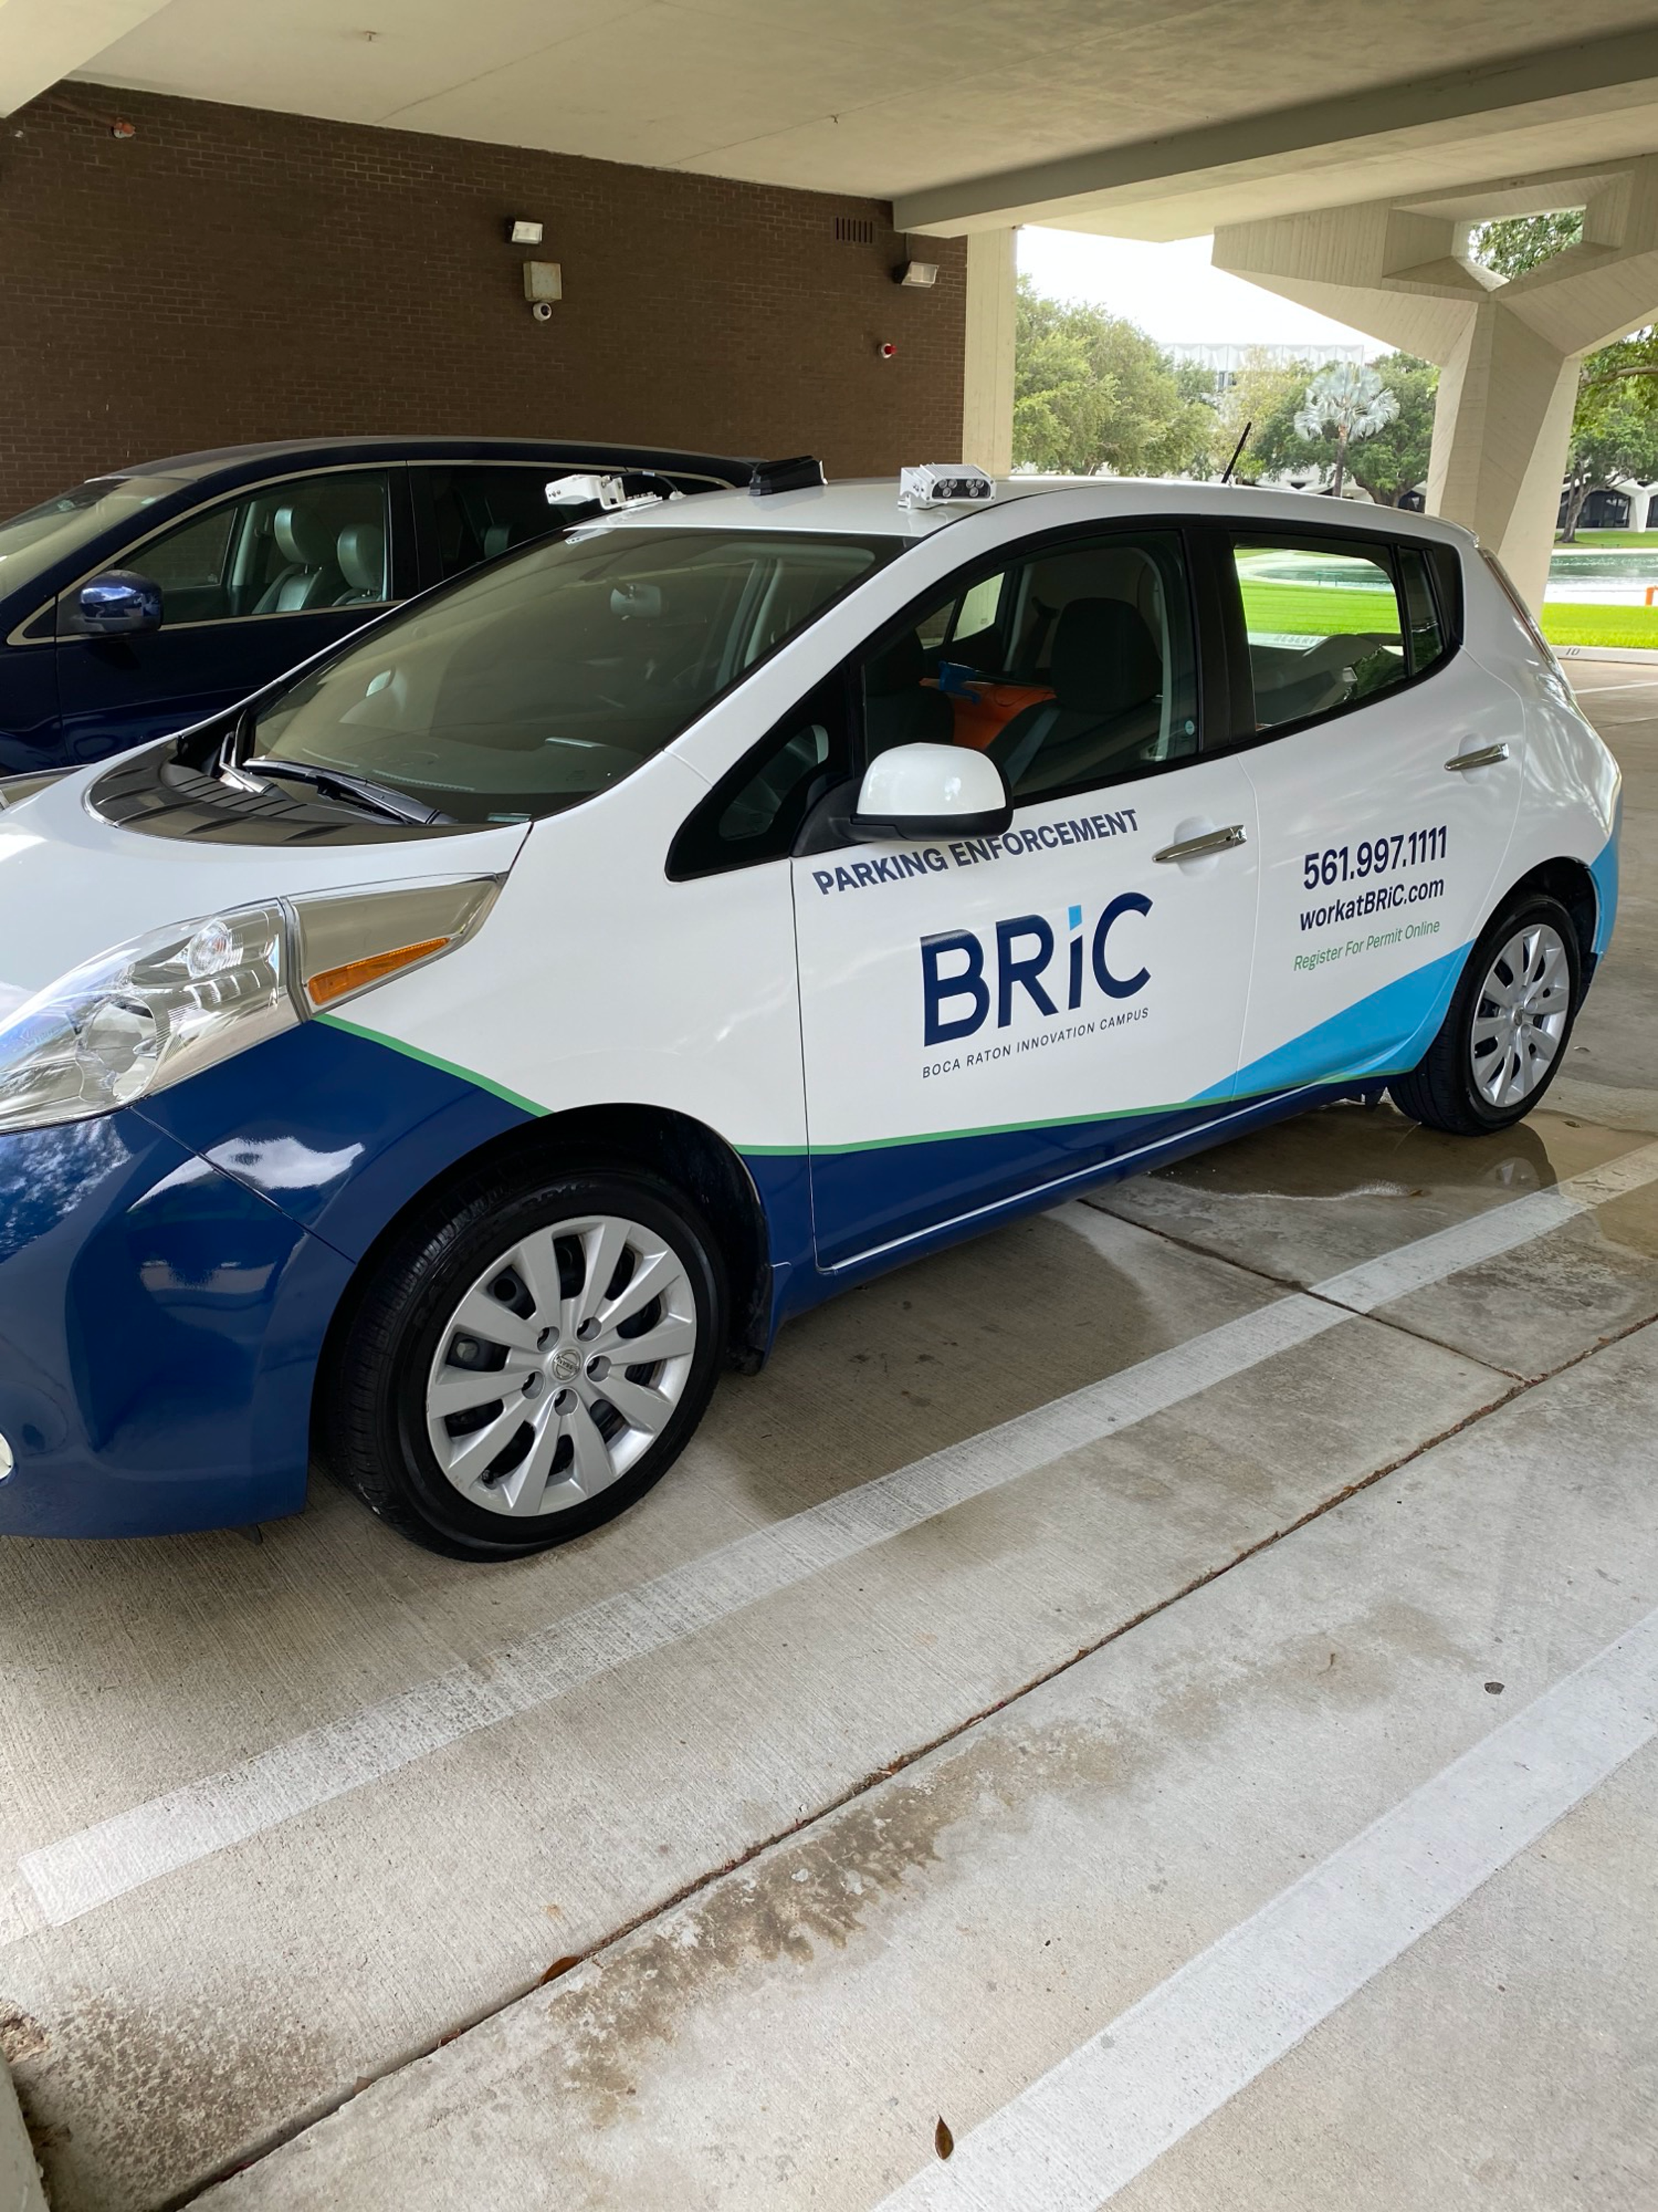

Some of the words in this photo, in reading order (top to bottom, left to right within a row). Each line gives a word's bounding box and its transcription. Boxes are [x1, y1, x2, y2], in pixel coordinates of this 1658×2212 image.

[812, 847, 948, 895] PARKING
[950, 809, 1139, 867] ENFORCEMENT
[1303, 825, 1447, 890] 561.997.1111
[1300, 879, 1444, 931] workatBRiC.com
[920, 892, 1153, 1046] BRiC
[1294, 946, 1343, 971] Register
[1345, 939, 1364, 956] For
[1366, 928, 1402, 951] Permit
[1405, 920, 1440, 940] Online
[922, 1058, 960, 1079] BOCA
[967, 1045, 1011, 1067] RATON
[1017, 1021, 1095, 1053] INNOVATION
[1100, 1007, 1150, 1031] CAMPUS
